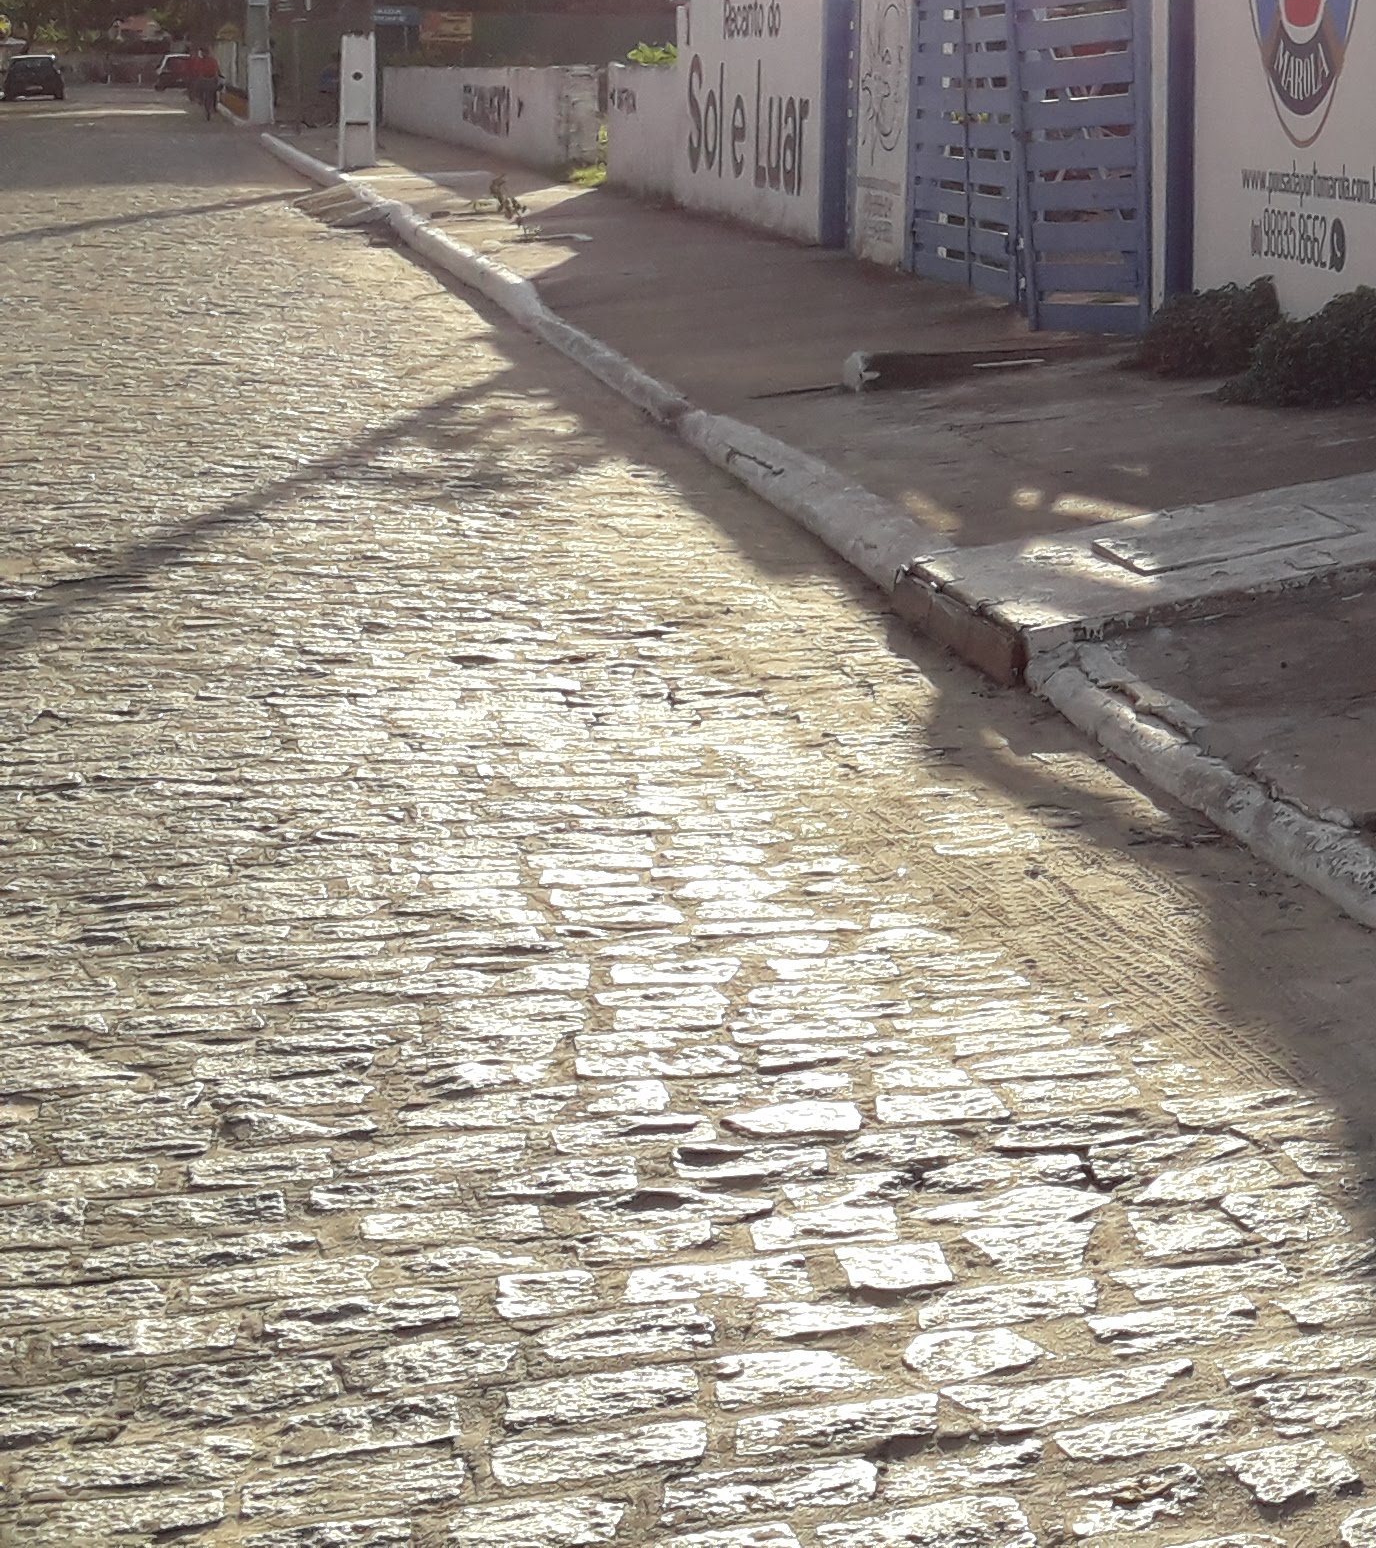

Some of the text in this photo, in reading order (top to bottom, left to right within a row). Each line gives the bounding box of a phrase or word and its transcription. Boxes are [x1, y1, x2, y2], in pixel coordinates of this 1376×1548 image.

[1273, 39, 1331, 102] MAROLA
[687, 53, 810, 197] Sol e Luar
